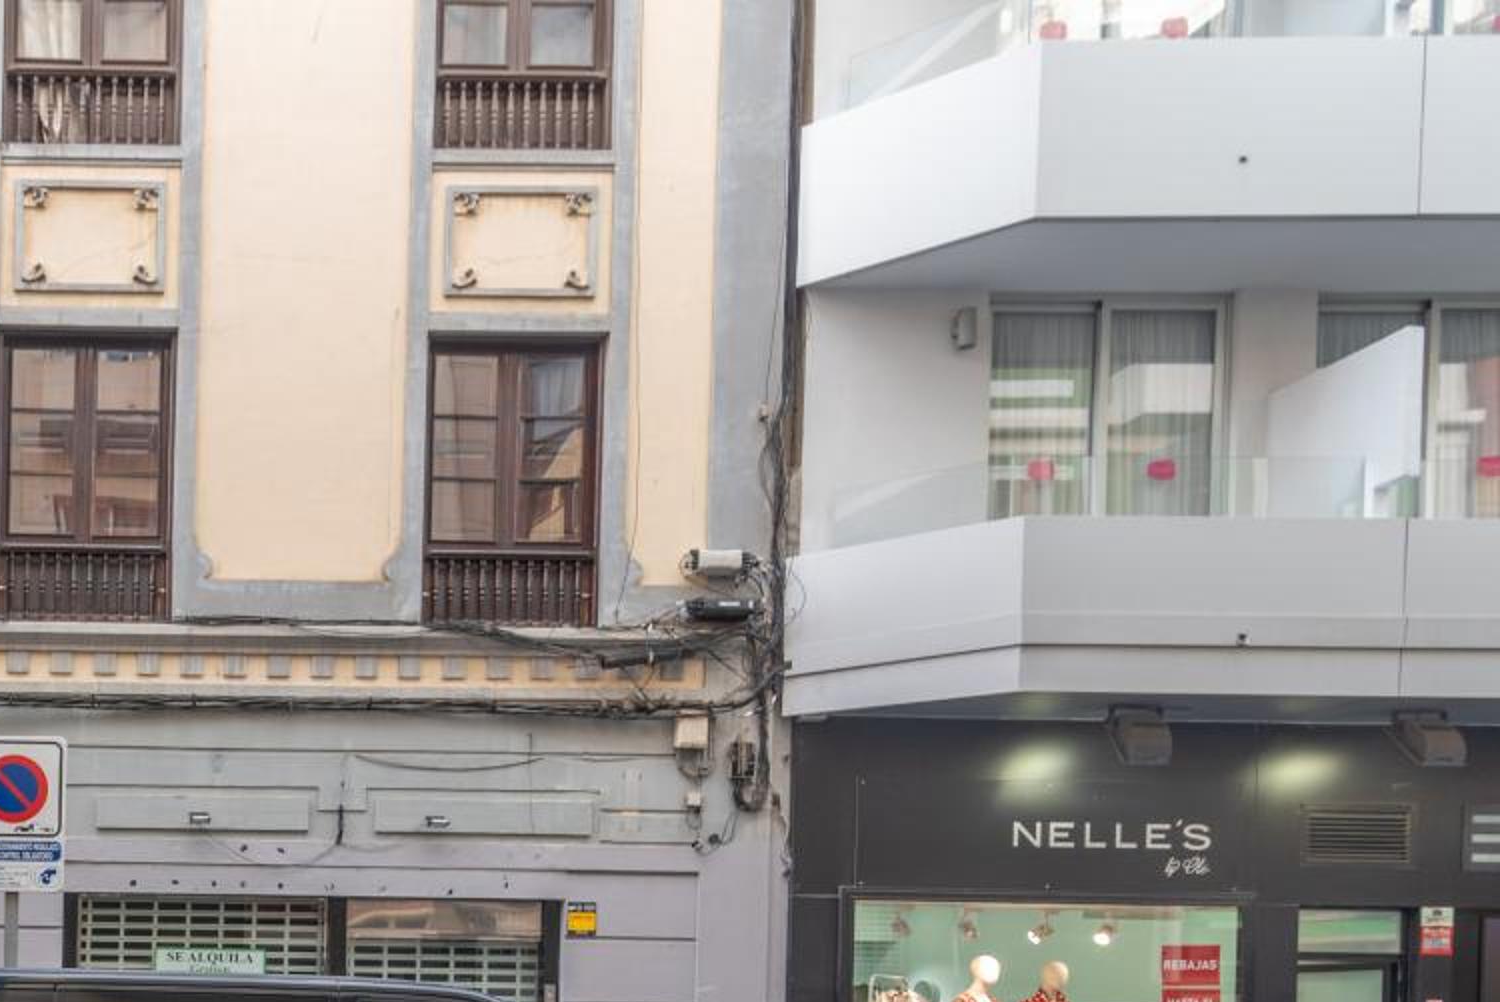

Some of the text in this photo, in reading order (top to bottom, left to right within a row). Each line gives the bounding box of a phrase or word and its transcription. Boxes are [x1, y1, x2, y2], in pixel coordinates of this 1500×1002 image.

[1012, 818, 1212, 851] NELLE'S
[166, 951, 256, 965] SE ALQUILA
[1163, 960, 1218, 971] REBAJAS
